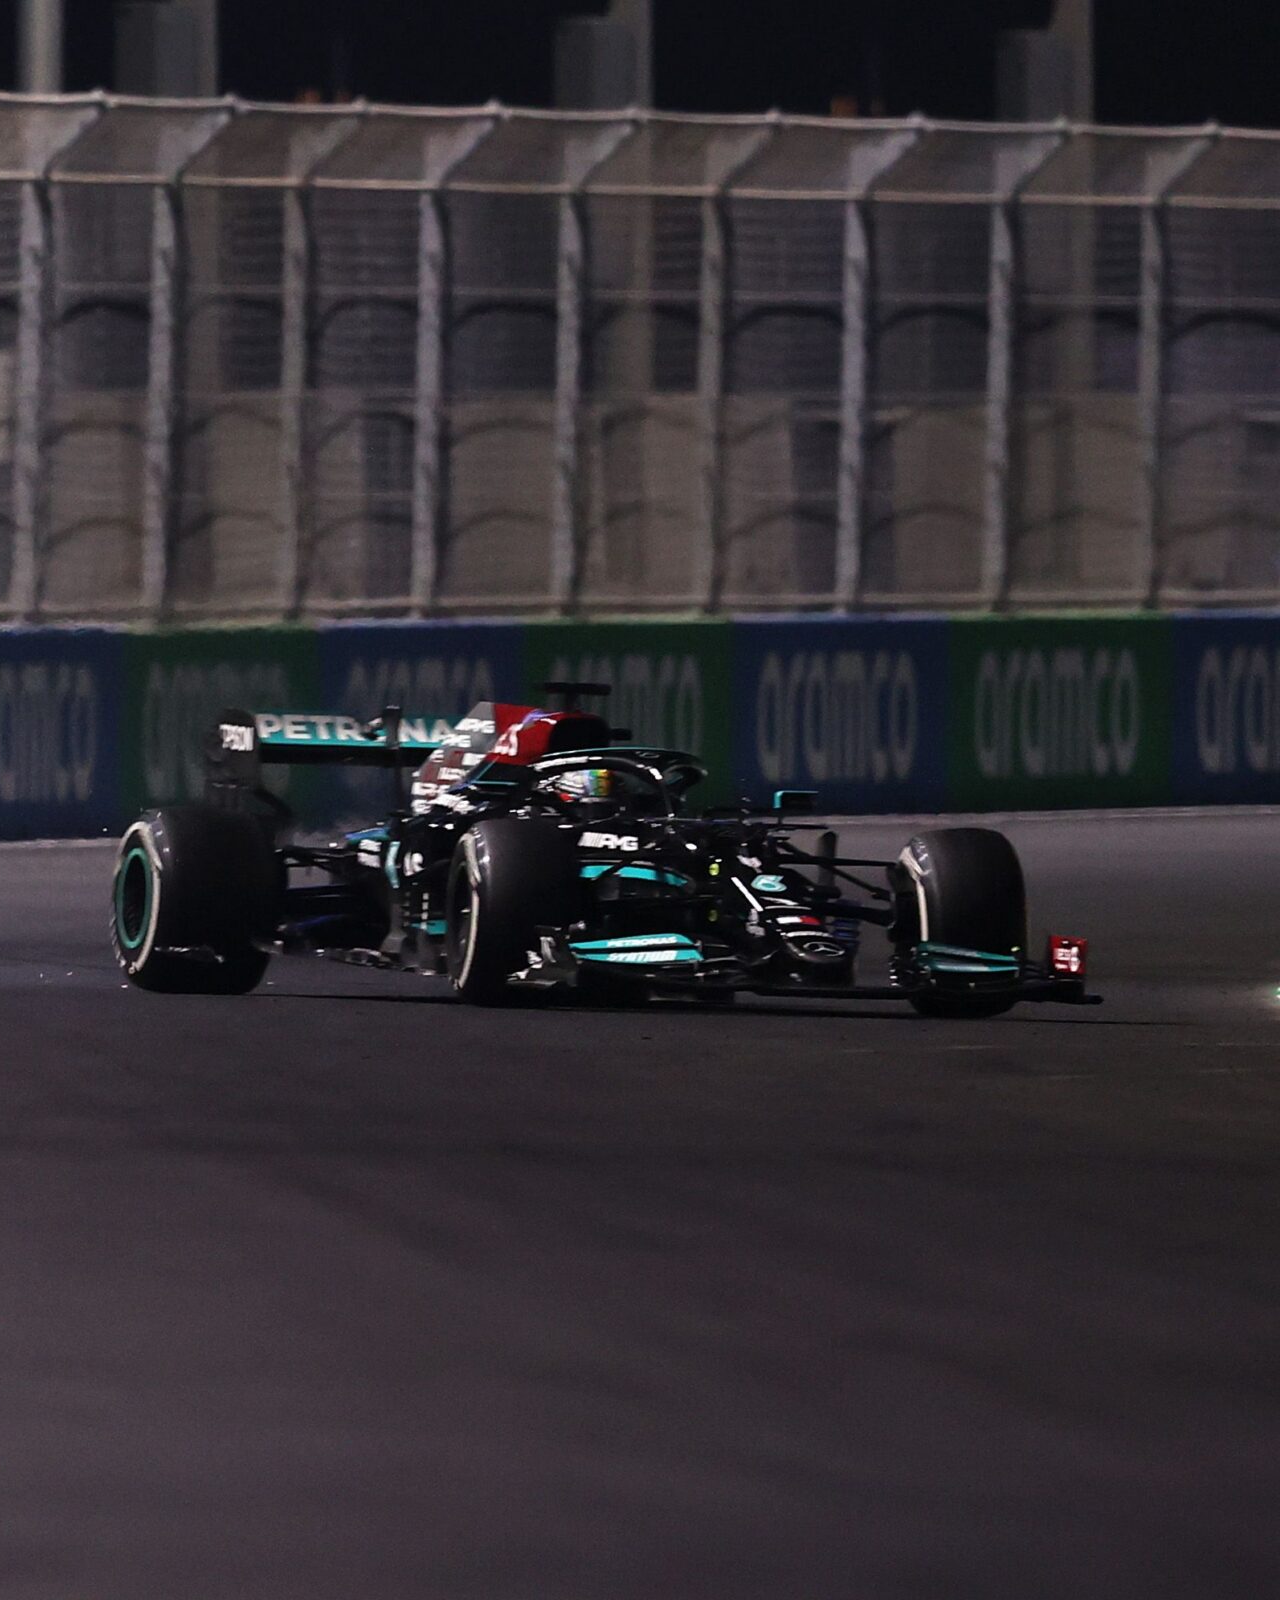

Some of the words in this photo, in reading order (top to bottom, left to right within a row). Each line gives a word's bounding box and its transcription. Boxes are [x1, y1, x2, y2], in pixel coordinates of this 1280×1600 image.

[756, 650, 919, 785] aramco
[974, 647, 1139, 778] aramco
[1195, 645, 1280, 773] ara
